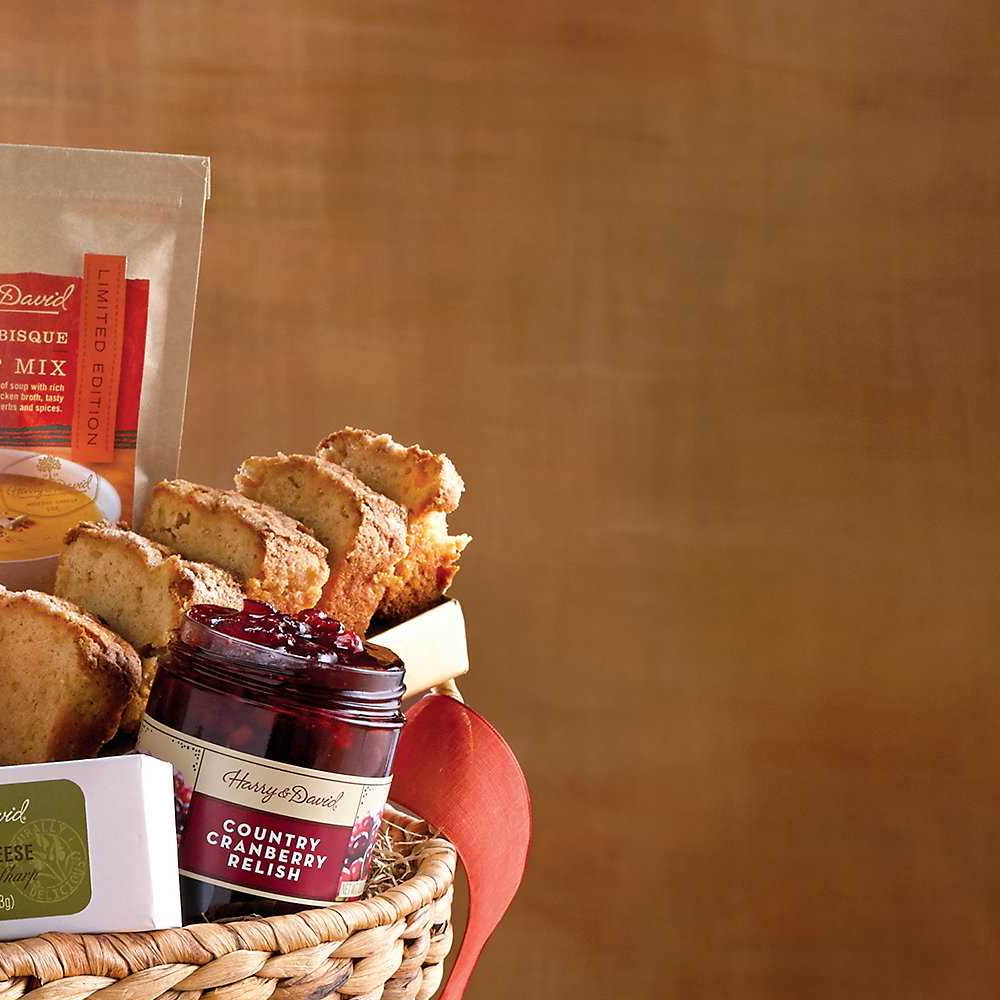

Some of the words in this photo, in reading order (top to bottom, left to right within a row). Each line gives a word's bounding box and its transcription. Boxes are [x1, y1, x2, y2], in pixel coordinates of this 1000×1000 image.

[94, 269, 110, 352] LIMITED
[14, 358, 67, 376] MIX
[0, 381, 8, 389] of
[10, 383, 29, 392] soup
[30, 382, 47, 391] with
[49, 383, 65, 392] rich
[21, 393, 43, 402] broth,
[45, 394, 65, 404] tasty
[19, 403, 34, 412] and
[35, 403, 63, 413] spices.
[87, 363, 104, 445] EDITION
[222, 818, 322, 851] COUNTRY
[206, 831, 328, 869] CRANBERRY
[227, 853, 301, 882] RELISH
